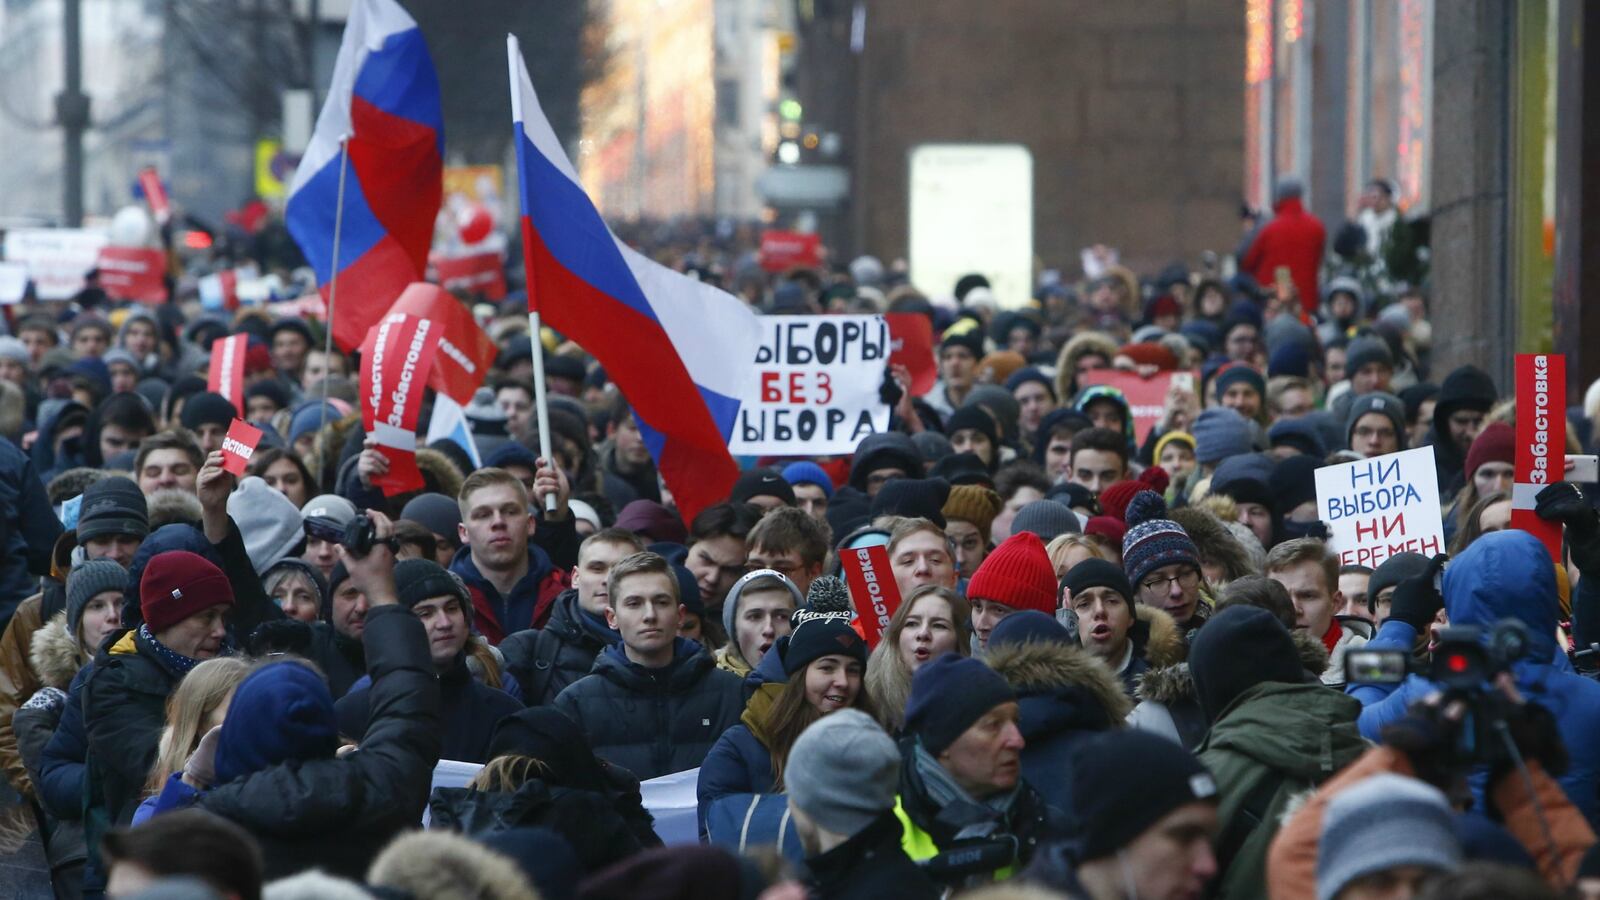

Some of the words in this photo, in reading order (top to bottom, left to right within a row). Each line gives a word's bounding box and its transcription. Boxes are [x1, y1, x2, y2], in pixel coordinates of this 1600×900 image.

[754, 321, 886, 365] ЫБОРЫ
[388, 319, 431, 428] Забастовка
[761, 372, 833, 405] БЕЗ
[742, 408, 876, 442] ЫБОРА
[1530, 355, 1548, 485] Забастовка
[1351, 458, 1401, 489] НИ
[1328, 482, 1422, 520] ВЫБОРА
[1355, 512, 1406, 543] НИ
[1338, 535, 1440, 569] ЕРЕМЕН
[857, 548, 890, 637] астовка
